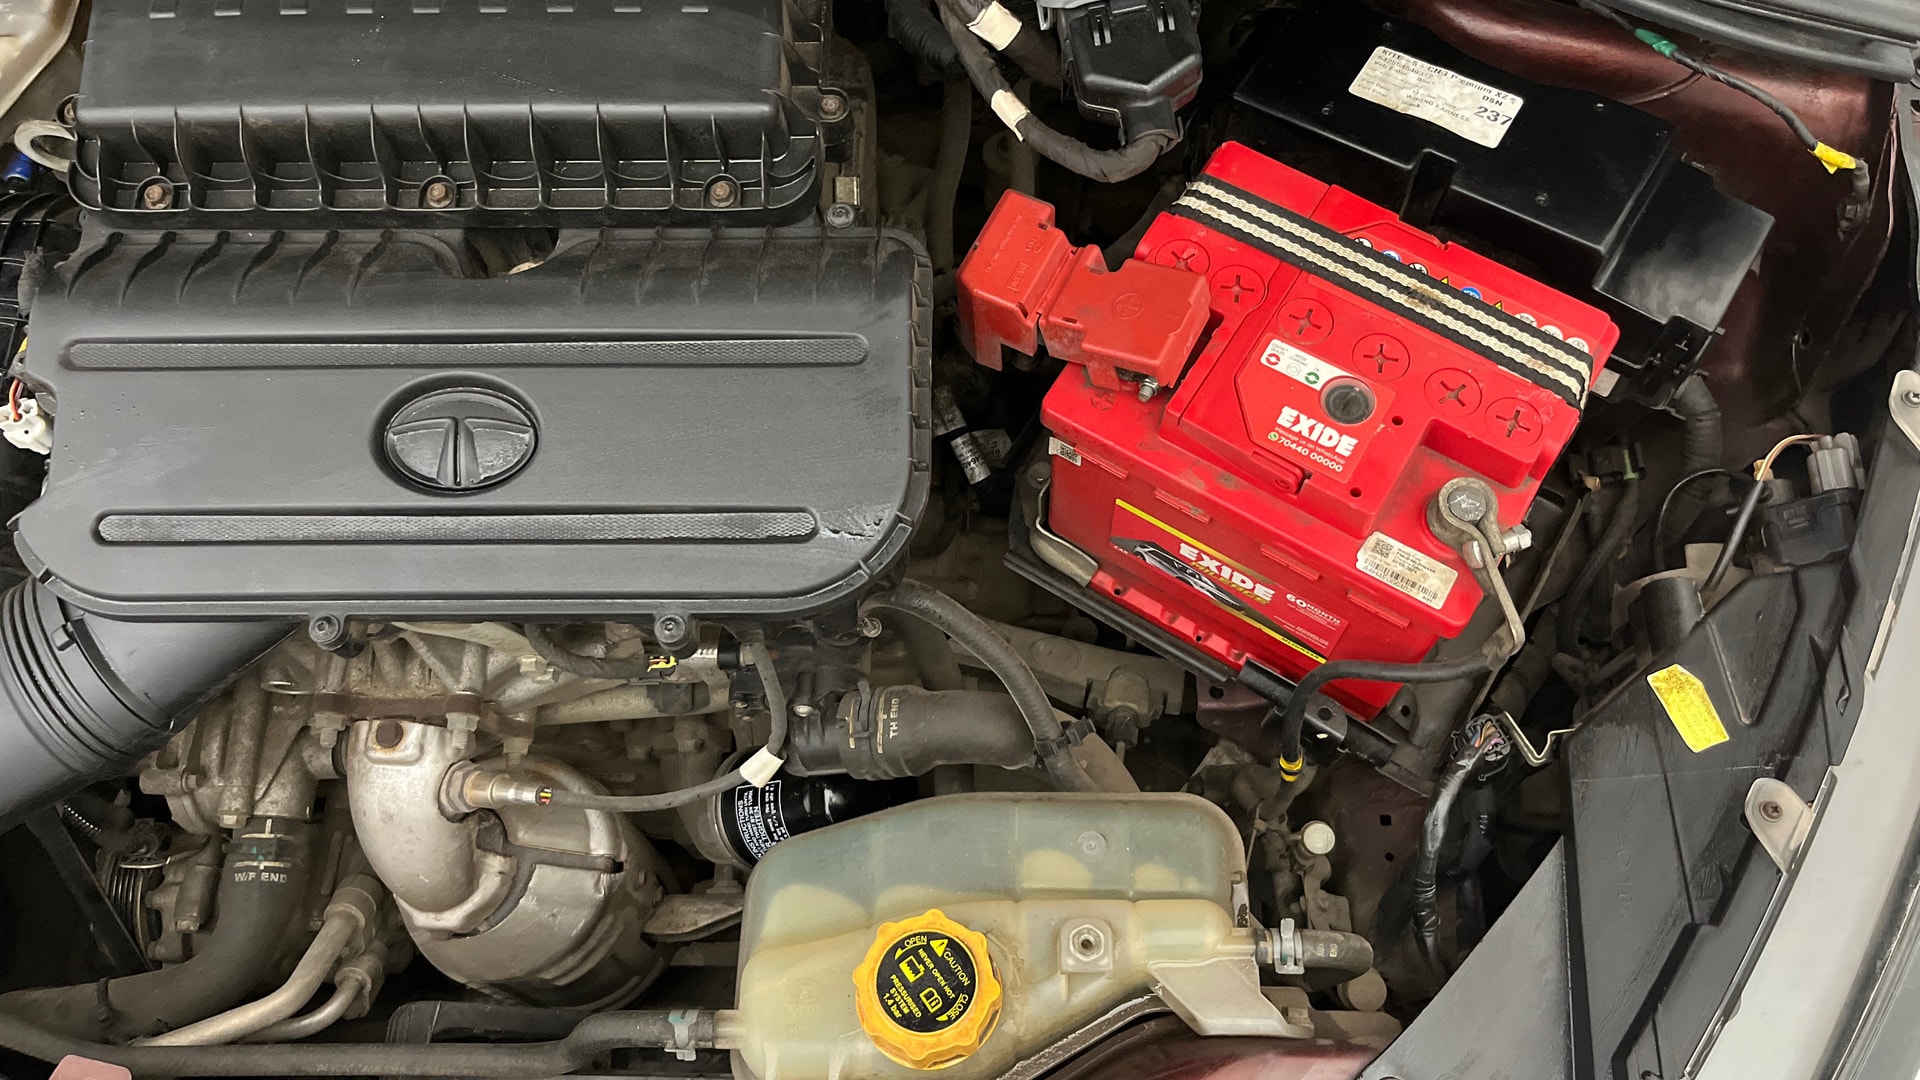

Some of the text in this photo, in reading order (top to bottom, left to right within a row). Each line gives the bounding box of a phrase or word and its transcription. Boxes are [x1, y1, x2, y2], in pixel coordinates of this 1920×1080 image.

[1451, 74, 1492, 94] Pemium
[1482, 95, 1503, 106] DSN
[1473, 106, 1512, 126] 237
[1276, 405, 1358, 457] EXIDE
[1278, 435, 1343, 472] 70440 00000
[1113, 545, 1129, 555] CAR
[1179, 542, 1276, 601] EXIDE
[1286, 593, 1307, 608] 60
[889, 698, 900, 739] TH END
[737, 800, 758, 853] INSTRUCTIONS
[753, 806, 767, 840] TIGHTEN
[234, 872, 288, 883] W/F END
[904, 935, 927, 947] OPEN
[918, 948, 956, 999] NEVER OPEN HOT
[943, 951, 970, 986] CAUTION
[883, 993, 902, 1018] 1.4 bar
[890, 974, 922, 1018] PRESSURISED
[890, 987, 910, 1015] SYSTEM
[948, 993, 969, 1020] CLOSE
